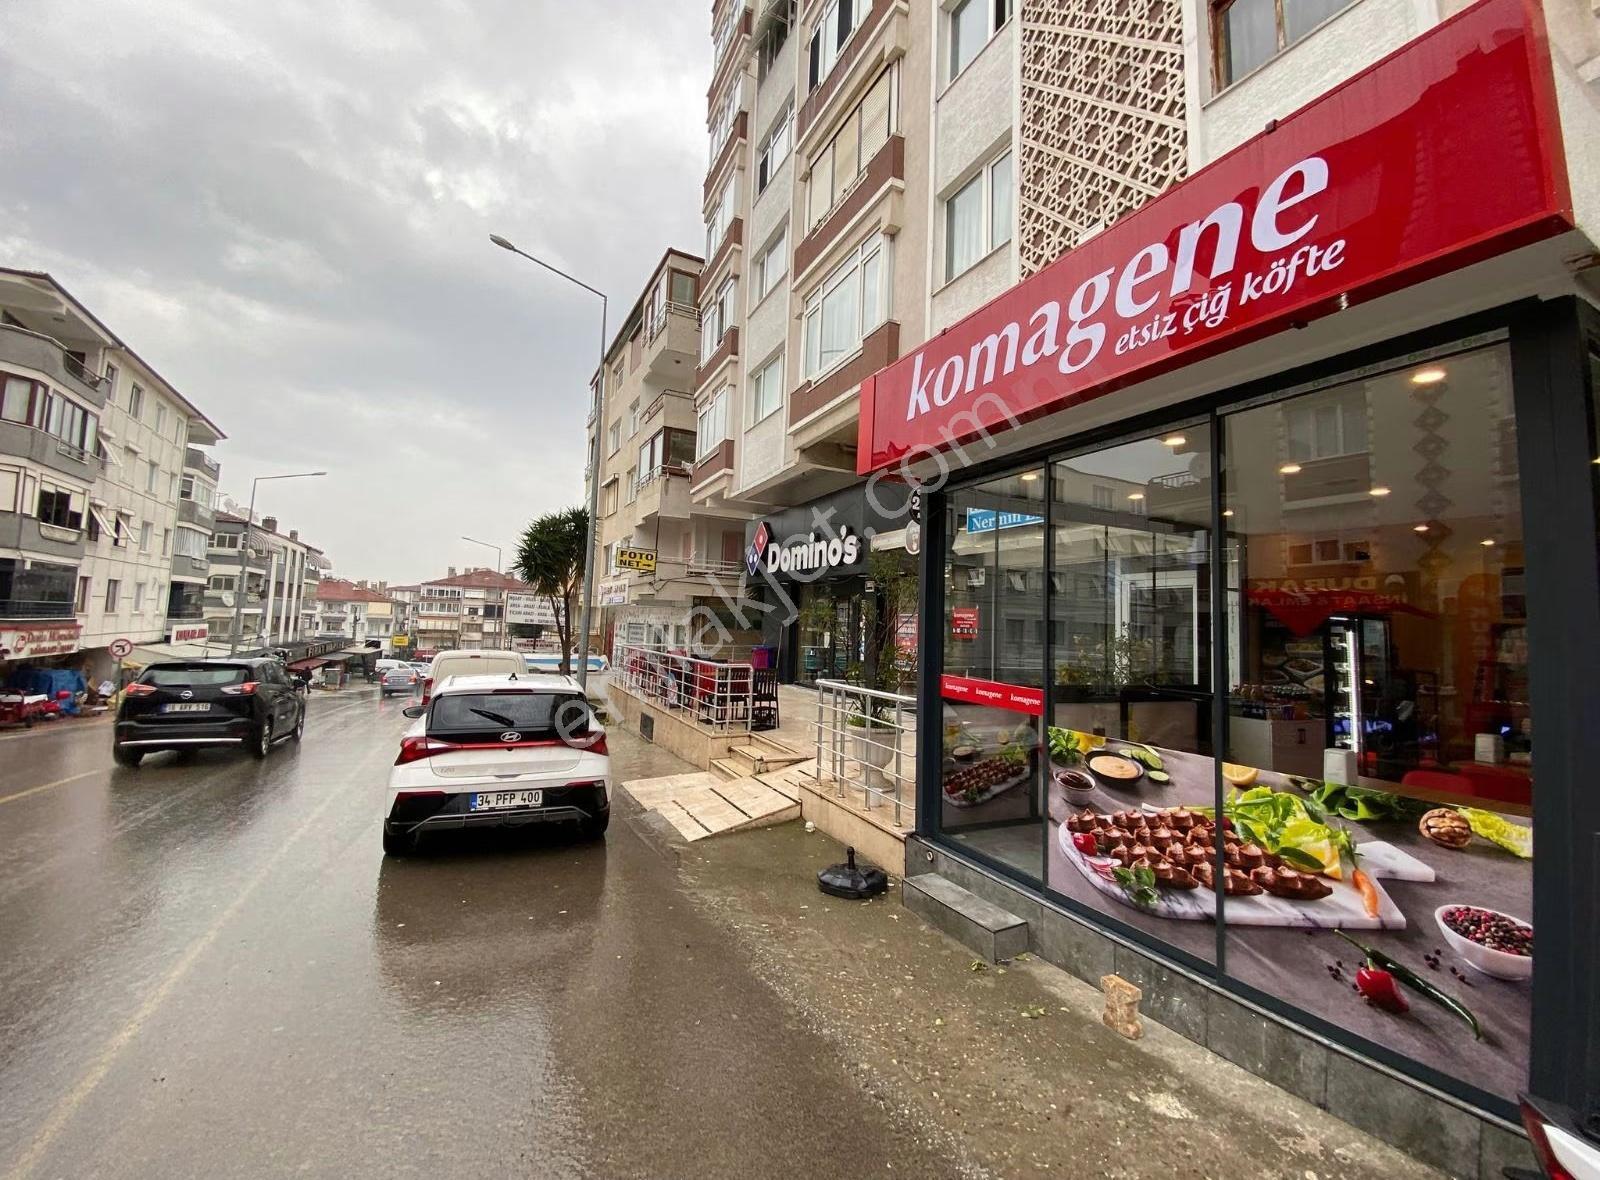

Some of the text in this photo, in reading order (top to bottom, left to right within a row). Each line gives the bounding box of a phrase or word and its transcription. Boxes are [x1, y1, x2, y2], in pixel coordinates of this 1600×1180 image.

[906, 156, 1329, 422] komagene
[1114, 239, 1346, 355] etsiz çiğ köfte
[620, 550, 653, 561] FOTO
[767, 524, 858, 574] Domino's
[945, 682, 1041, 706] komagene komagene komagene
[477, 795, 491, 806] 34
[495, 793, 516, 805] PFP
[520, 791, 540, 803] 400
